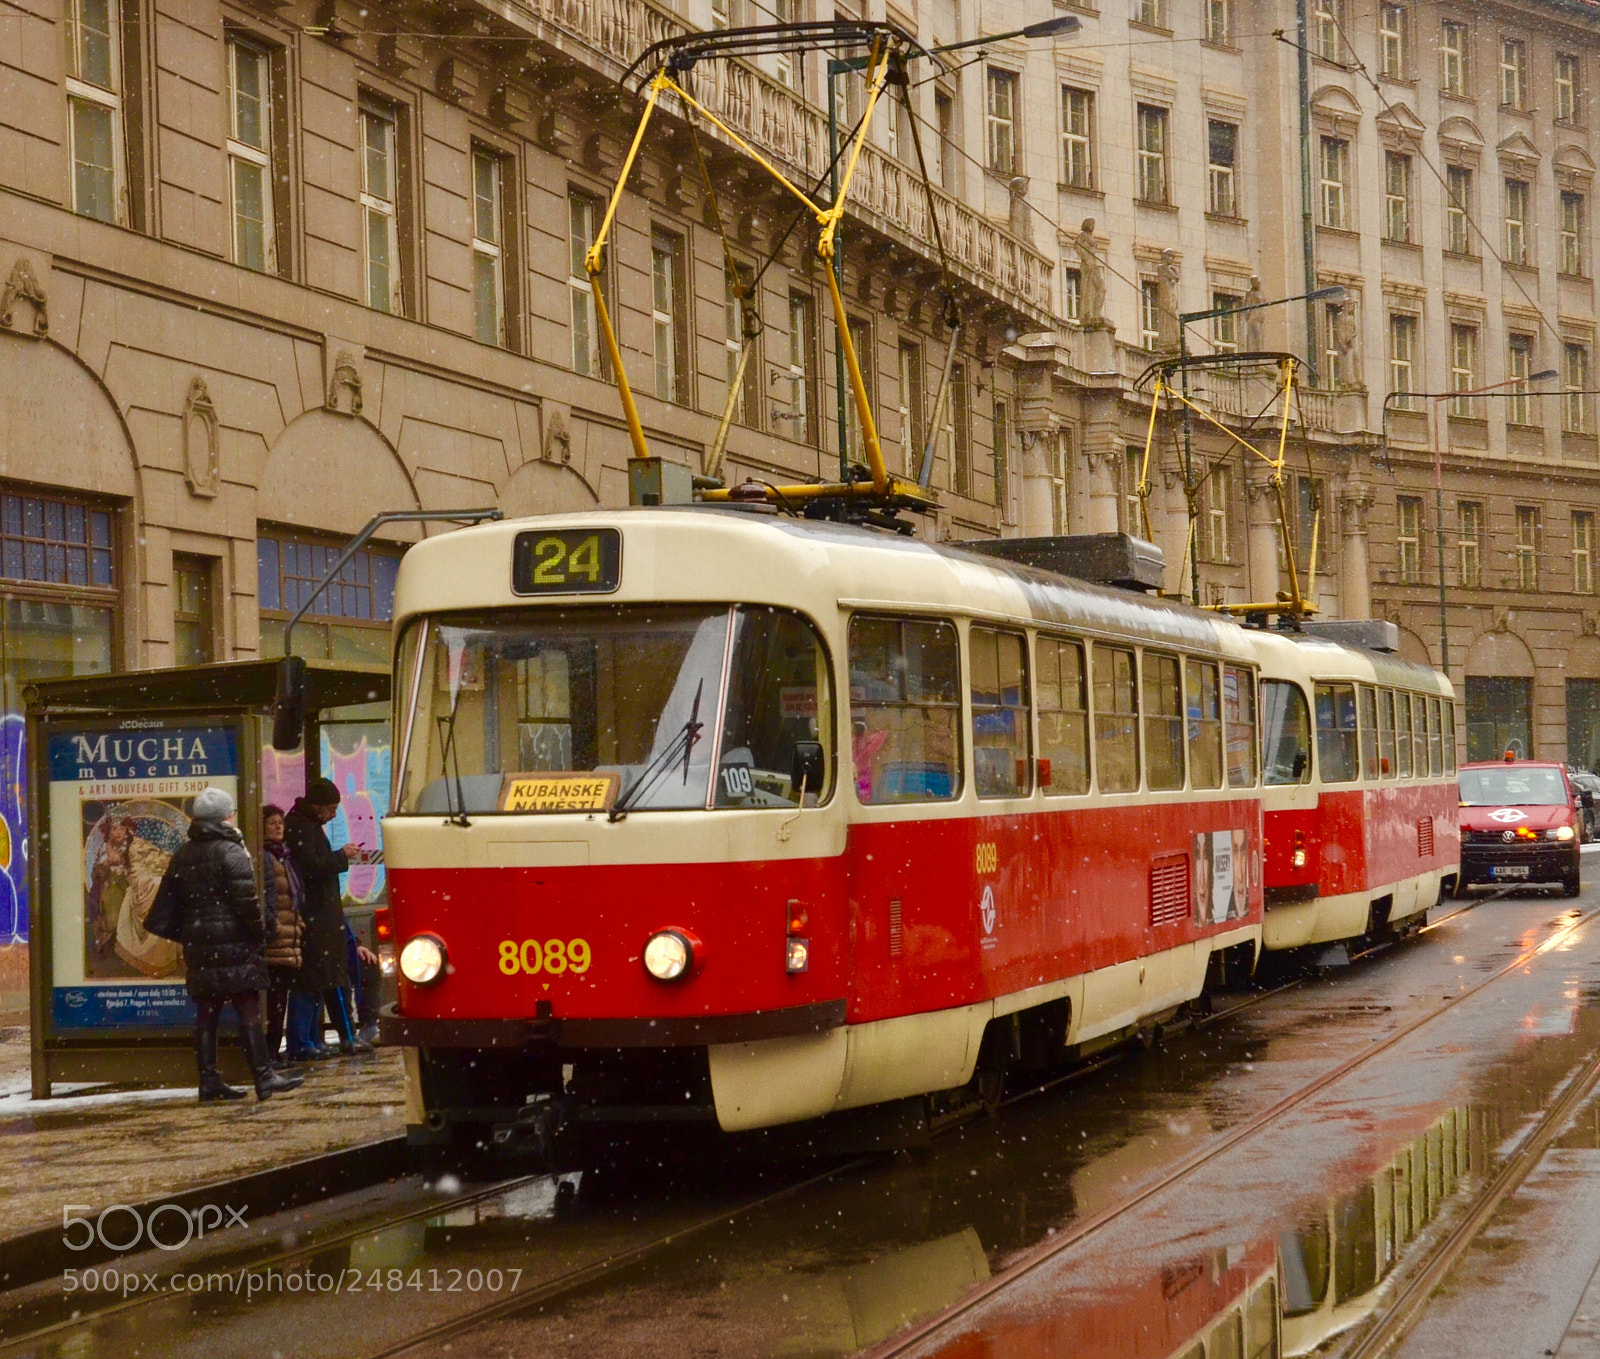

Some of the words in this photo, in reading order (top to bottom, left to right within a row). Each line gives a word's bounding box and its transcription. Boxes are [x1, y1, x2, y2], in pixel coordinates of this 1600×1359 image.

[534, 536, 600, 584] 24
[119, 720, 164, 730] JCDecaux
[75, 735, 208, 764] MUCHA
[78, 763, 208, 779] museum
[721, 767, 753, 794] 109
[89, 784, 106, 795] ART
[111, 783, 154, 795] NOUVEAU
[159, 781, 179, 793] GIFT
[513, 781, 604, 798] KUBÁNSKÉ
[976, 842, 997, 874] 8089
[498, 938, 592, 976] 8089
